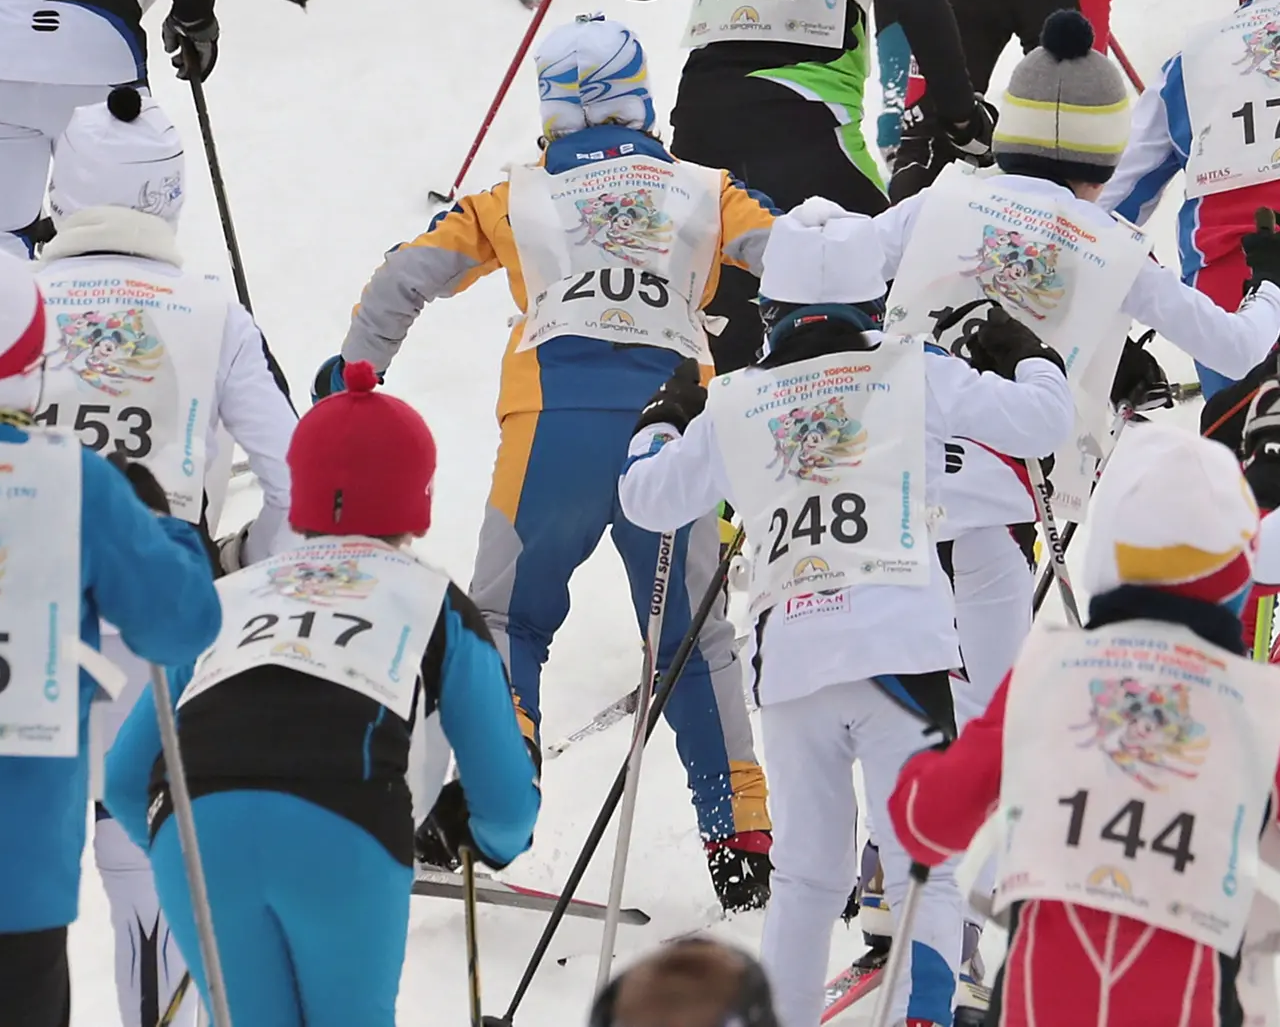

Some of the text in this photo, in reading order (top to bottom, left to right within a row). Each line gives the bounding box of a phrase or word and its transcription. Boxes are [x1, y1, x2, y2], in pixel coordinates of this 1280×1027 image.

[968, 201, 1022, 226] CASTELLO
[1025, 223, 1038, 232] DI
[1040, 228, 1079, 252] FIEMME
[1003, 207, 1077, 242] SCI DI FONDO
[1010, 202, 1053, 219] TROFEO
[562, 268, 669, 308] 205
[773, 376, 854, 398] SCI DI FONDO
[776, 372, 820, 388] TROFEO
[745, 394, 796, 418] CASTELLO
[801, 391, 813, 401] DI
[817, 382, 860, 396] FIEMME
[36, 404, 152, 462] 153
[767, 492, 870, 565] 248
[650, 532, 673, 615] GODI sport
[795, 594, 844, 609] PAVAN
[238, 611, 374, 648] 217
[1059, 790, 1195, 873] 144
